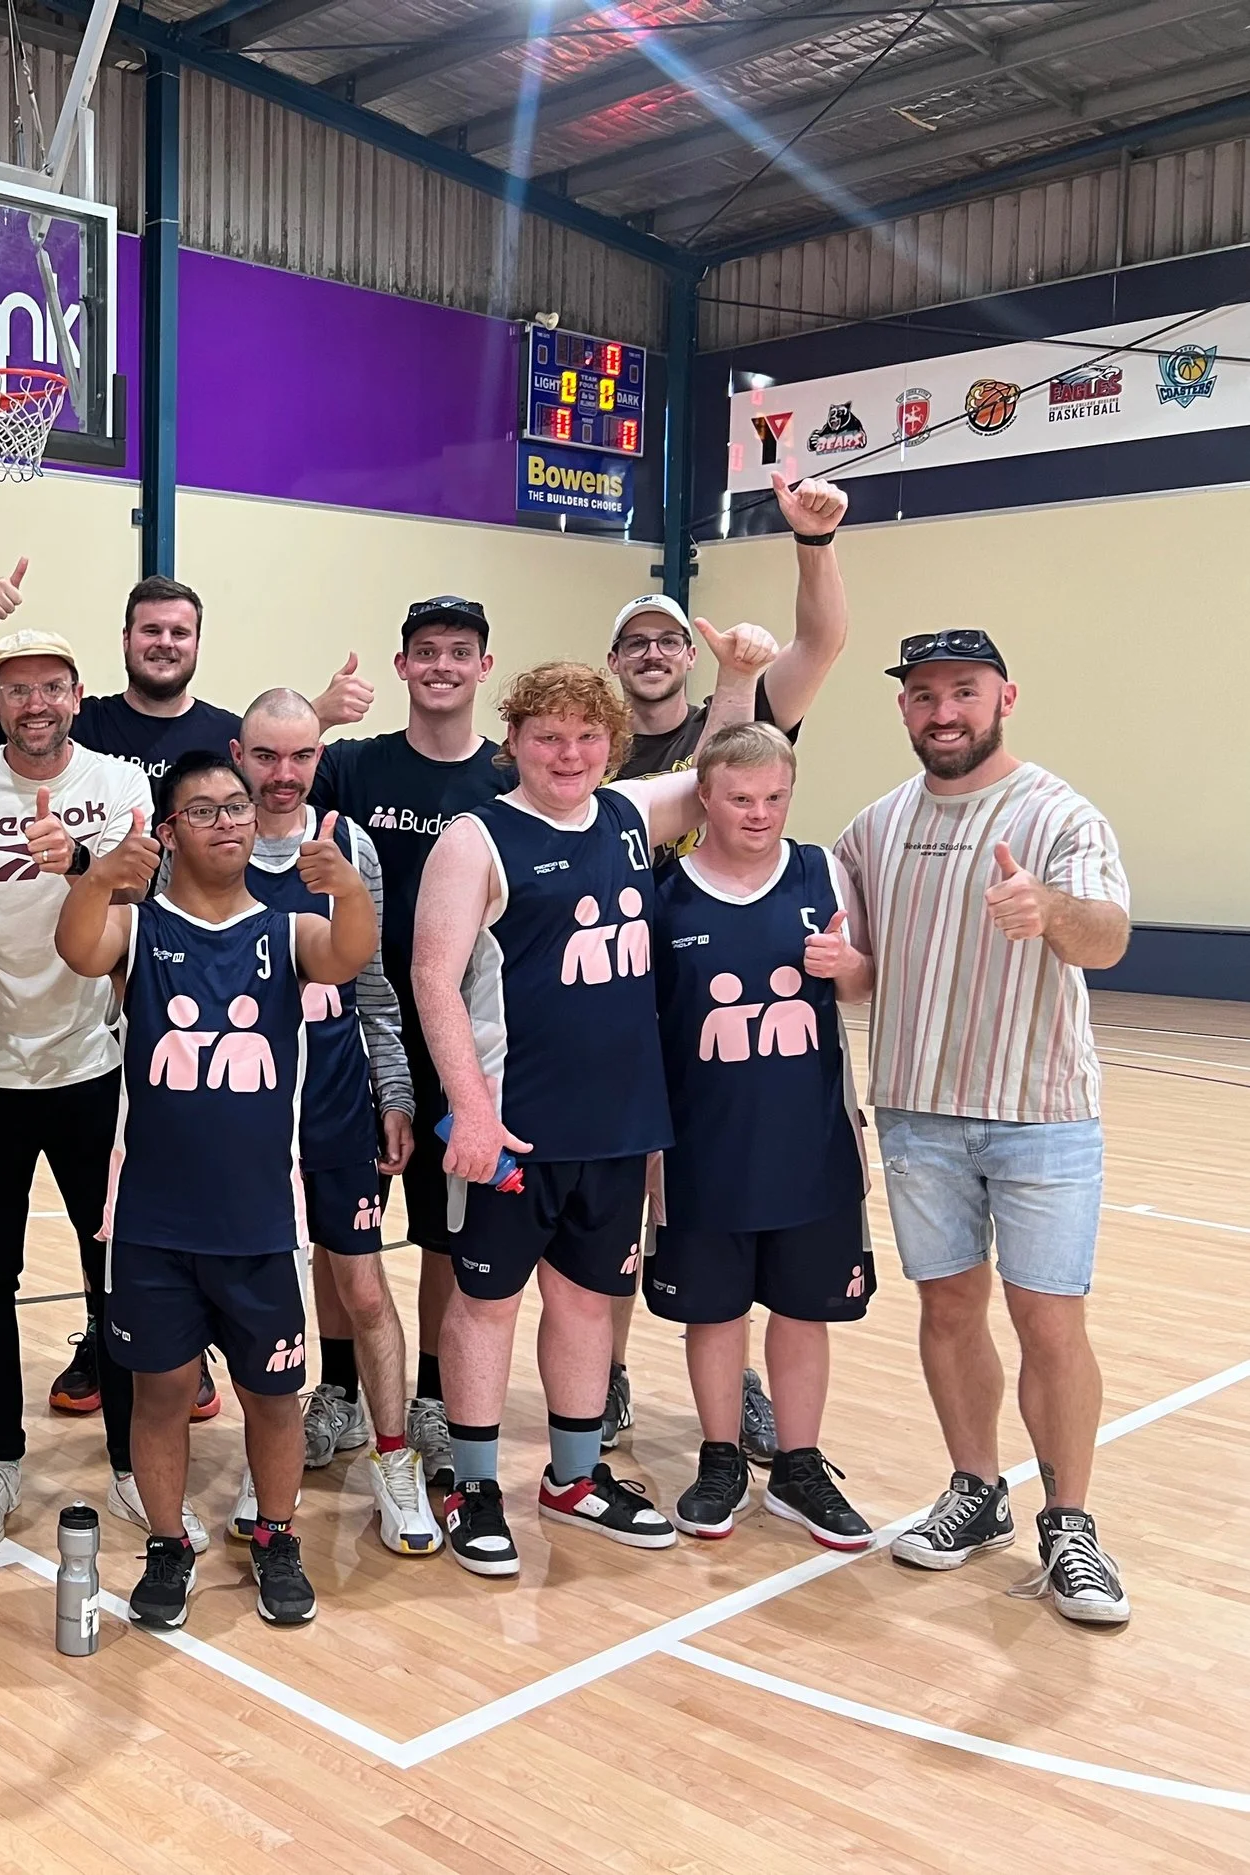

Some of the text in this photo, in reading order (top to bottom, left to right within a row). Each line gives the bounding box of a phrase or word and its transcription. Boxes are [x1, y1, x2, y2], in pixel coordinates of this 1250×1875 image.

[534, 376, 561, 391] LIGHT
[1049, 370, 1123, 405] EAGLES
[1160, 380, 1213, 400] COASTERS
[617, 393, 639, 407] DARK
[1049, 402, 1121, 422] BASKETBALL
[816, 432, 864, 452] BEARS
[528, 455, 623, 498] Bowens
[528, 490, 622, 513] THE BUILDERS CHOICE
[904, 842, 973, 851] Weekend Studios
[800, 907, 820, 934] 5
[256, 934, 271, 980] 9
